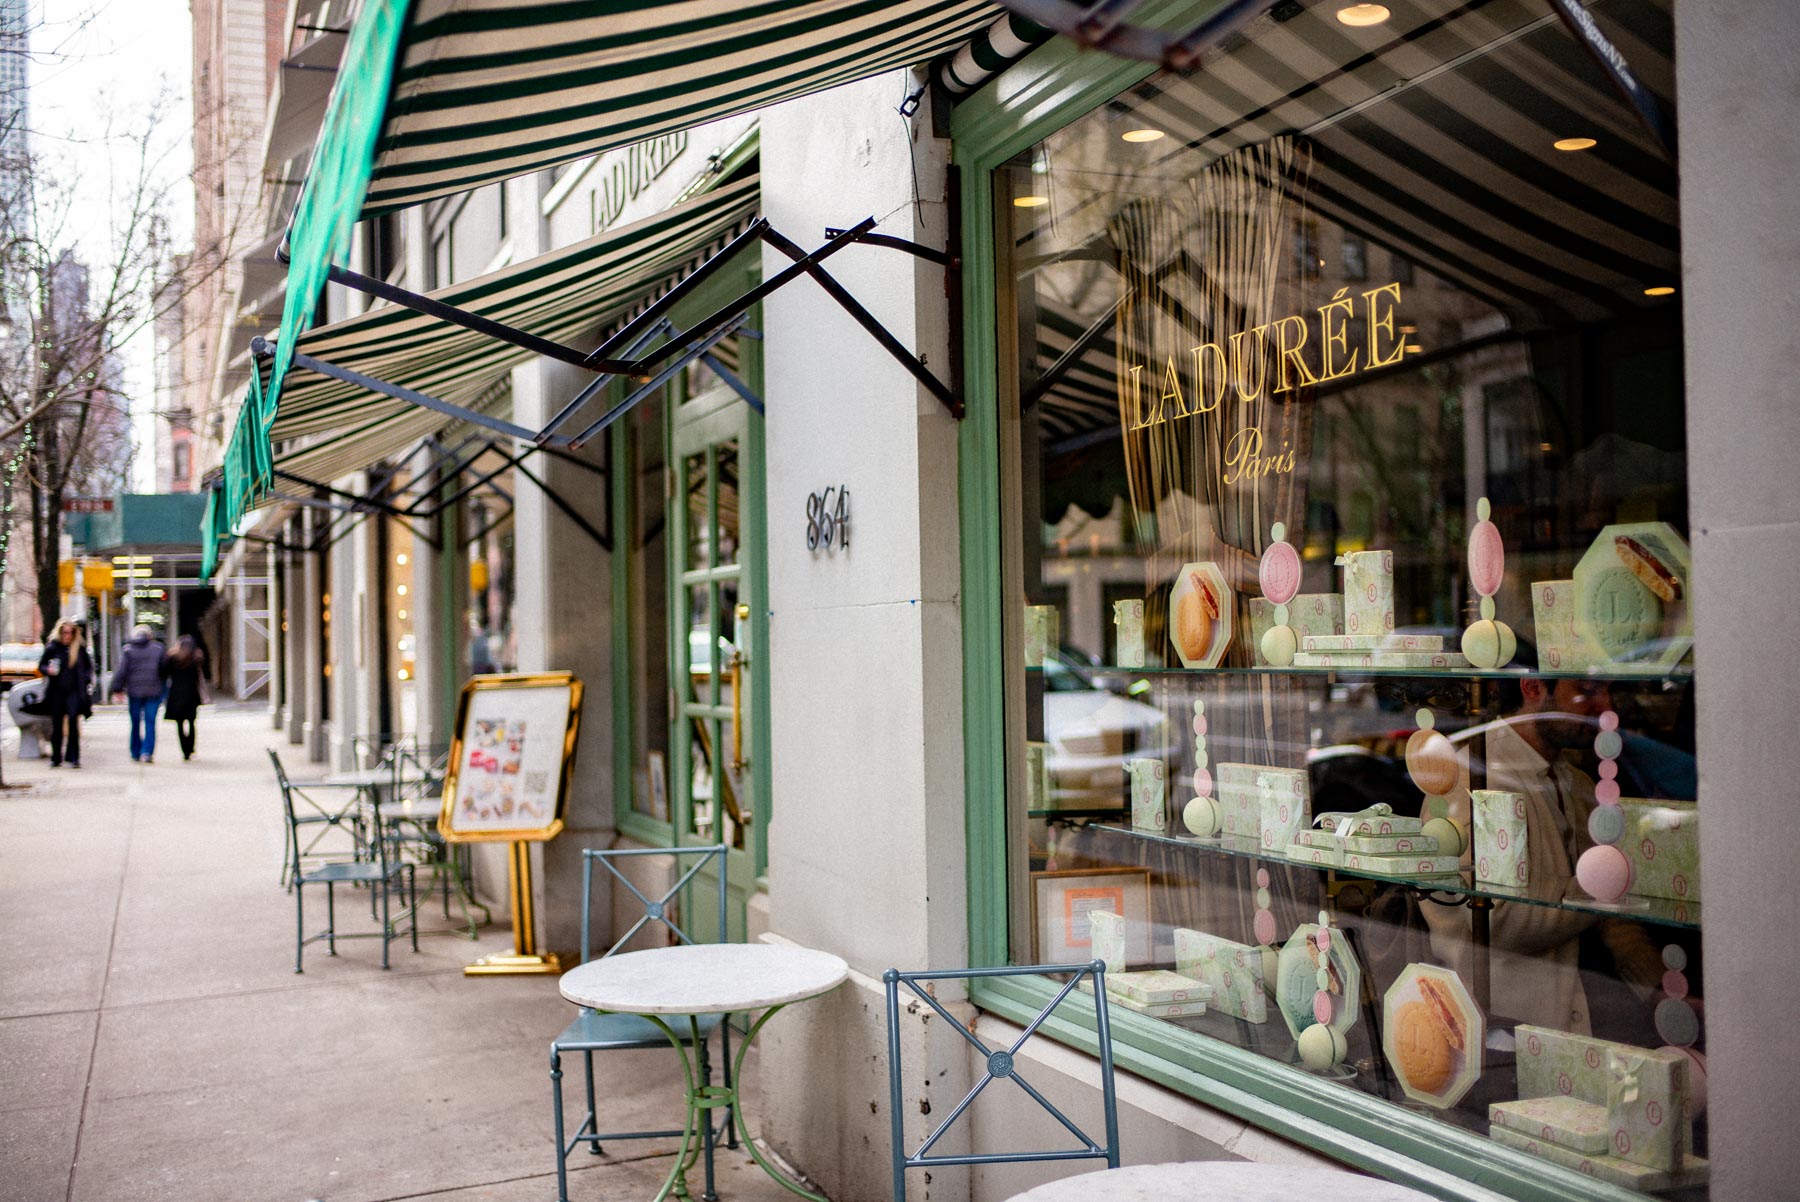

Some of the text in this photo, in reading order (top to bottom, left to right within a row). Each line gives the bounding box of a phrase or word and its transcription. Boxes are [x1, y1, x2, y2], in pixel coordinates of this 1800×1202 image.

[1129, 282, 1407, 431] LADURÉE
[1223, 427, 1297, 485] Paris
[806, 484, 850, 552] 864
